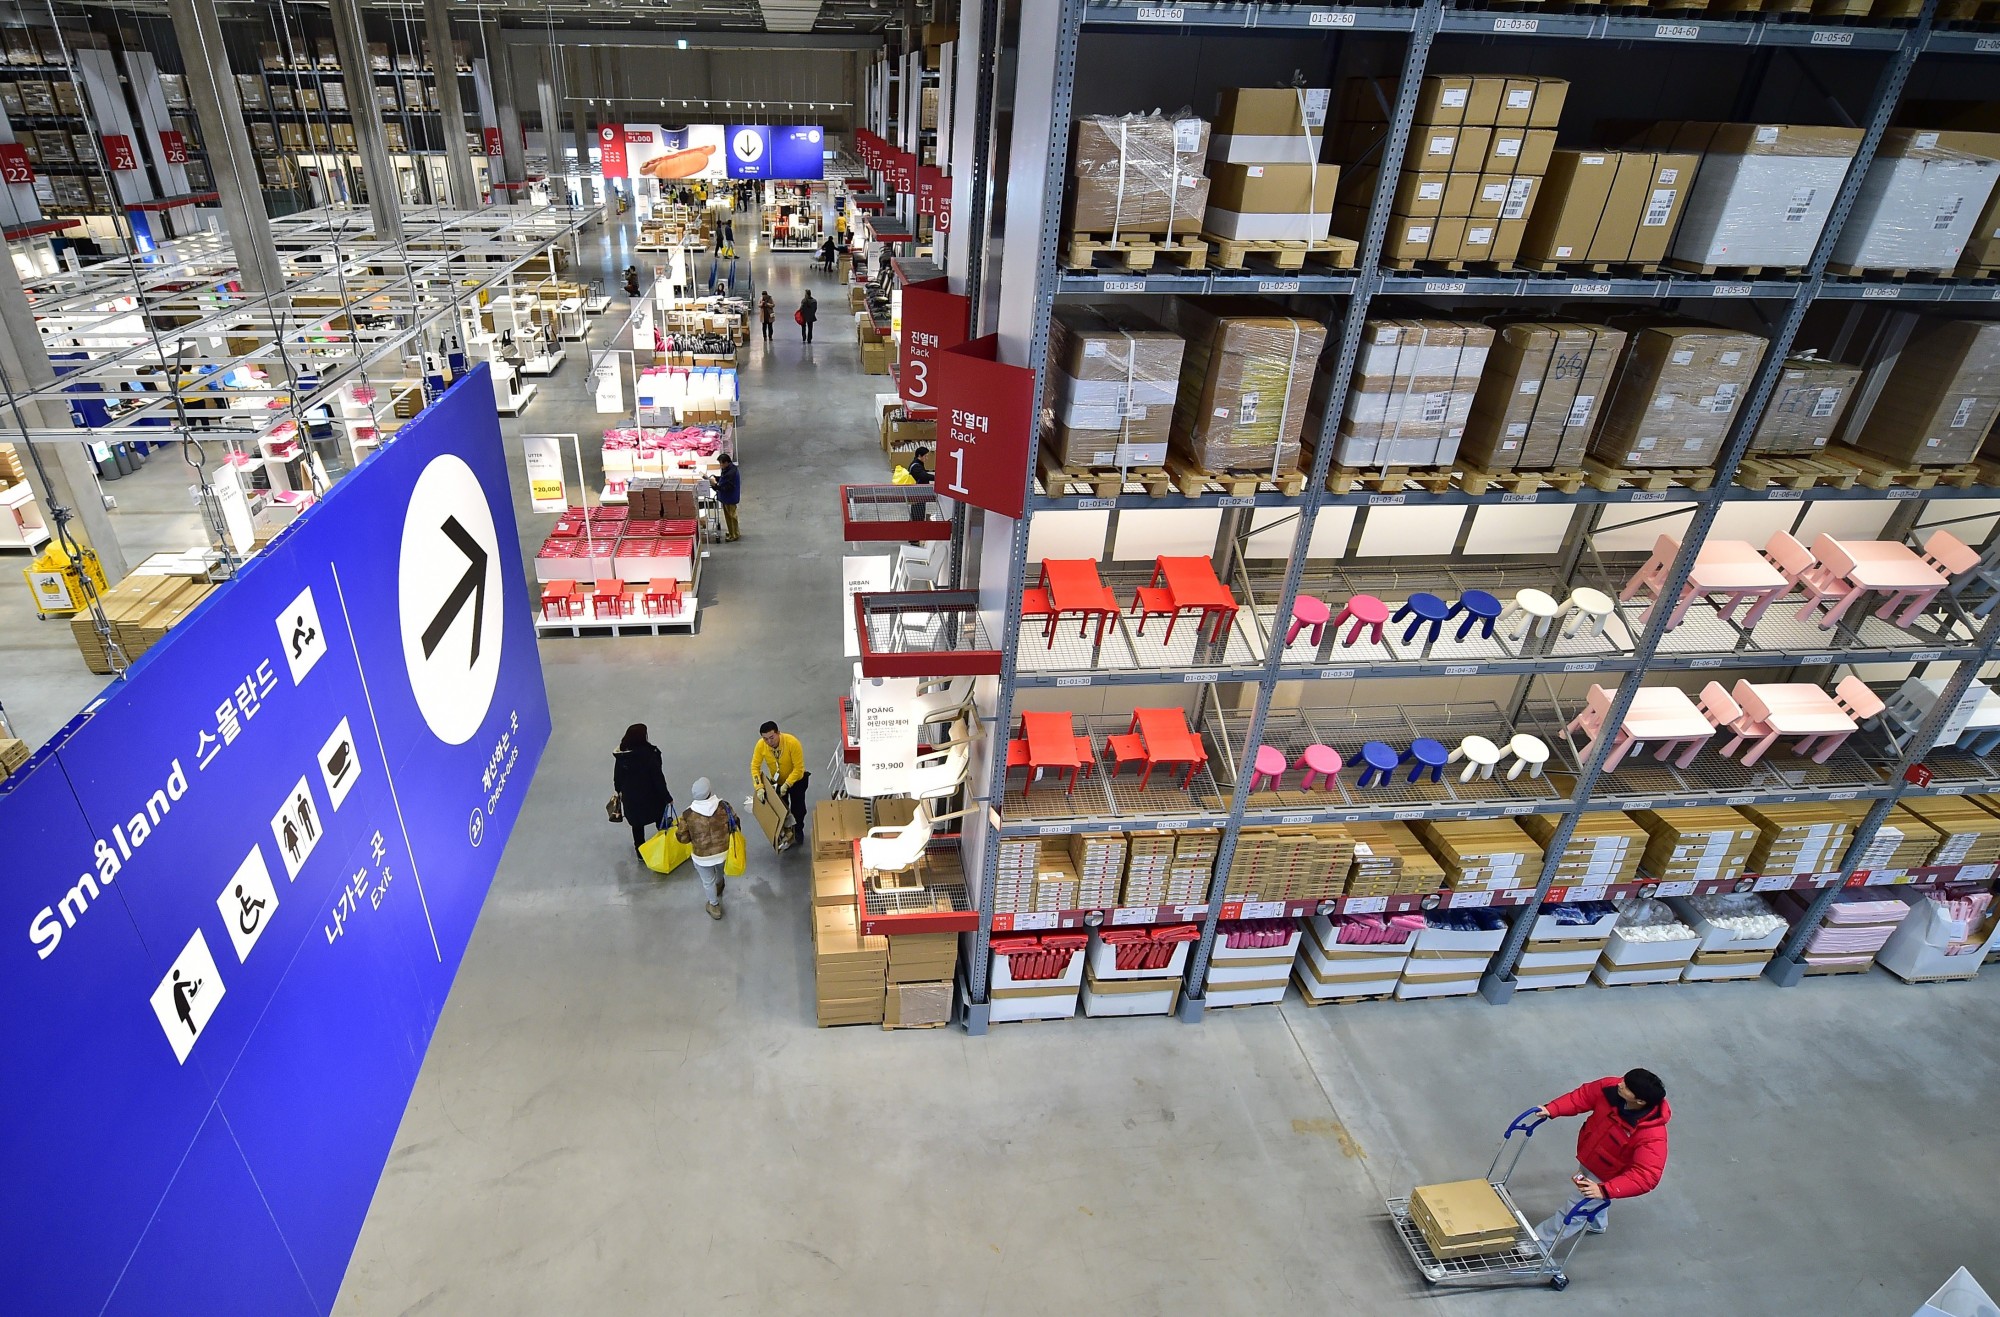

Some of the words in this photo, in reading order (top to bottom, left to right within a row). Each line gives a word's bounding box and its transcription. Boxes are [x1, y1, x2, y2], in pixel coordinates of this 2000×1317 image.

[1140, 9, 1182, 19] 01-01-60
[1311, 13, 1354, 24] 01-02-60
[1496, 19, 1537, 30] 01-03-60
[1658, 26, 1697, 37] 01-04-60
[1813, 32, 1852, 43] 01-05-60
[490, 145, 501, 154] 28
[168, 150, 185, 162] 26
[115, 157, 133, 168] 24
[872, 159, 882, 170] 17
[6, 168, 30, 182] 22
[897, 178, 910, 192] 13
[921, 196, 935, 213] 11
[940, 212, 949, 230] 9
[1104, 282, 1144, 291] 01-01-50
[1260, 282, 1298, 291] 01-02-50
[1426, 282, 1463, 291] 01-03-50
[1573, 285, 1609, 293] 01-04-50
[1715, 286, 1750, 295] 01-05-50
[1865, 288, 1899, 297] 01-06-50
[911, 331, 939, 349] 진열대
[910, 346, 929, 358] Rack
[908, 360, 928, 398] 3
[951, 409, 989, 434] 진열대
[951, 429, 976, 445] Rack
[948, 448, 969, 495] 1
[1504, 493, 1536, 502] 01-04-40
[1633, 492, 1665, 501] 01-05-40
[1770, 490, 1800, 499] 01-06-40
[1889, 490, 1919, 498] 01-07-40
[1080, 499, 1115, 508] 01-01-40
[1220, 497, 1254, 506] 01-02-40
[1370, 495, 1404, 504] 01-03-40
[1565, 663, 1595, 671] 01-05-30
[1691, 659, 1721, 667] 01-06-30
[1322, 670, 1353, 678] 01-03-30
[1446, 666, 1477, 674] 01-04-30
[1185, 674, 1217, 682] 01-02-30
[195, 657, 278, 772] 스몰란드
[482, 731, 510, 792] 계산하는
[510, 710, 518, 734] 곳
[487, 746, 518, 815] Check-outs
[1916, 777, 1923, 786] 1
[1041, 825, 1071, 833] 01-01-20
[1158, 821, 1187, 829] 01-02-20
[29, 758, 188, 960] Småland
[324, 867, 369, 945] 나가는
[370, 830, 386, 867] 곳
[370, 866, 393, 911] Exit
